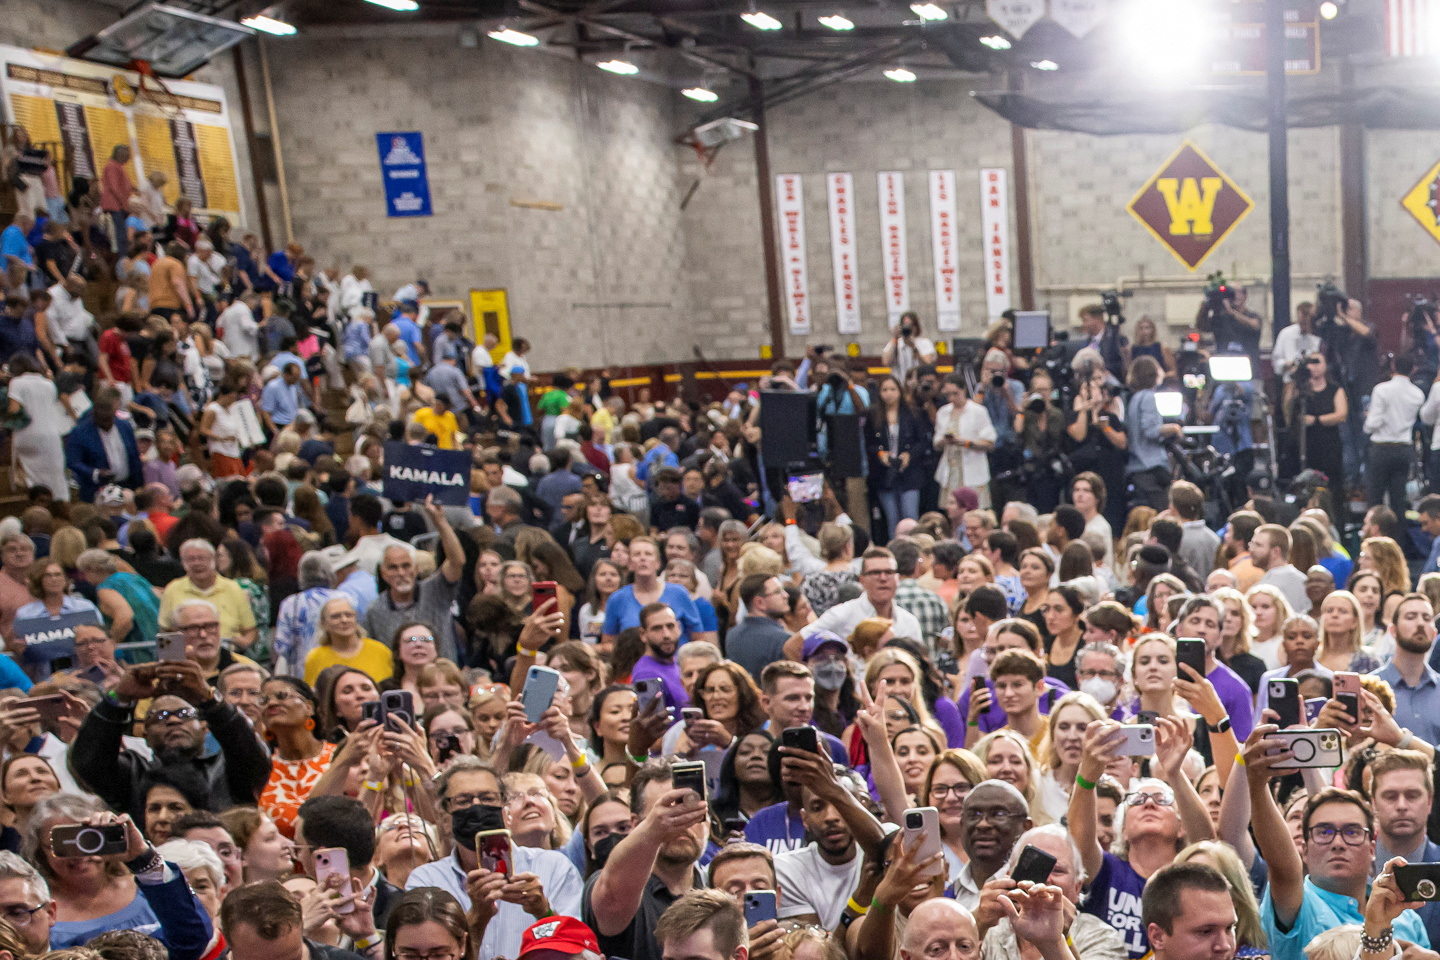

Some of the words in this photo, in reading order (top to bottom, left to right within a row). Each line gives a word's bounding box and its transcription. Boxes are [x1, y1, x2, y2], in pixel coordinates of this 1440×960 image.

[989, 173, 999, 207] DAN
[992, 223, 1004, 295] JANSEN
[390, 465, 465, 487] KAMALA
[25, 627, 75, 645] KAMA
